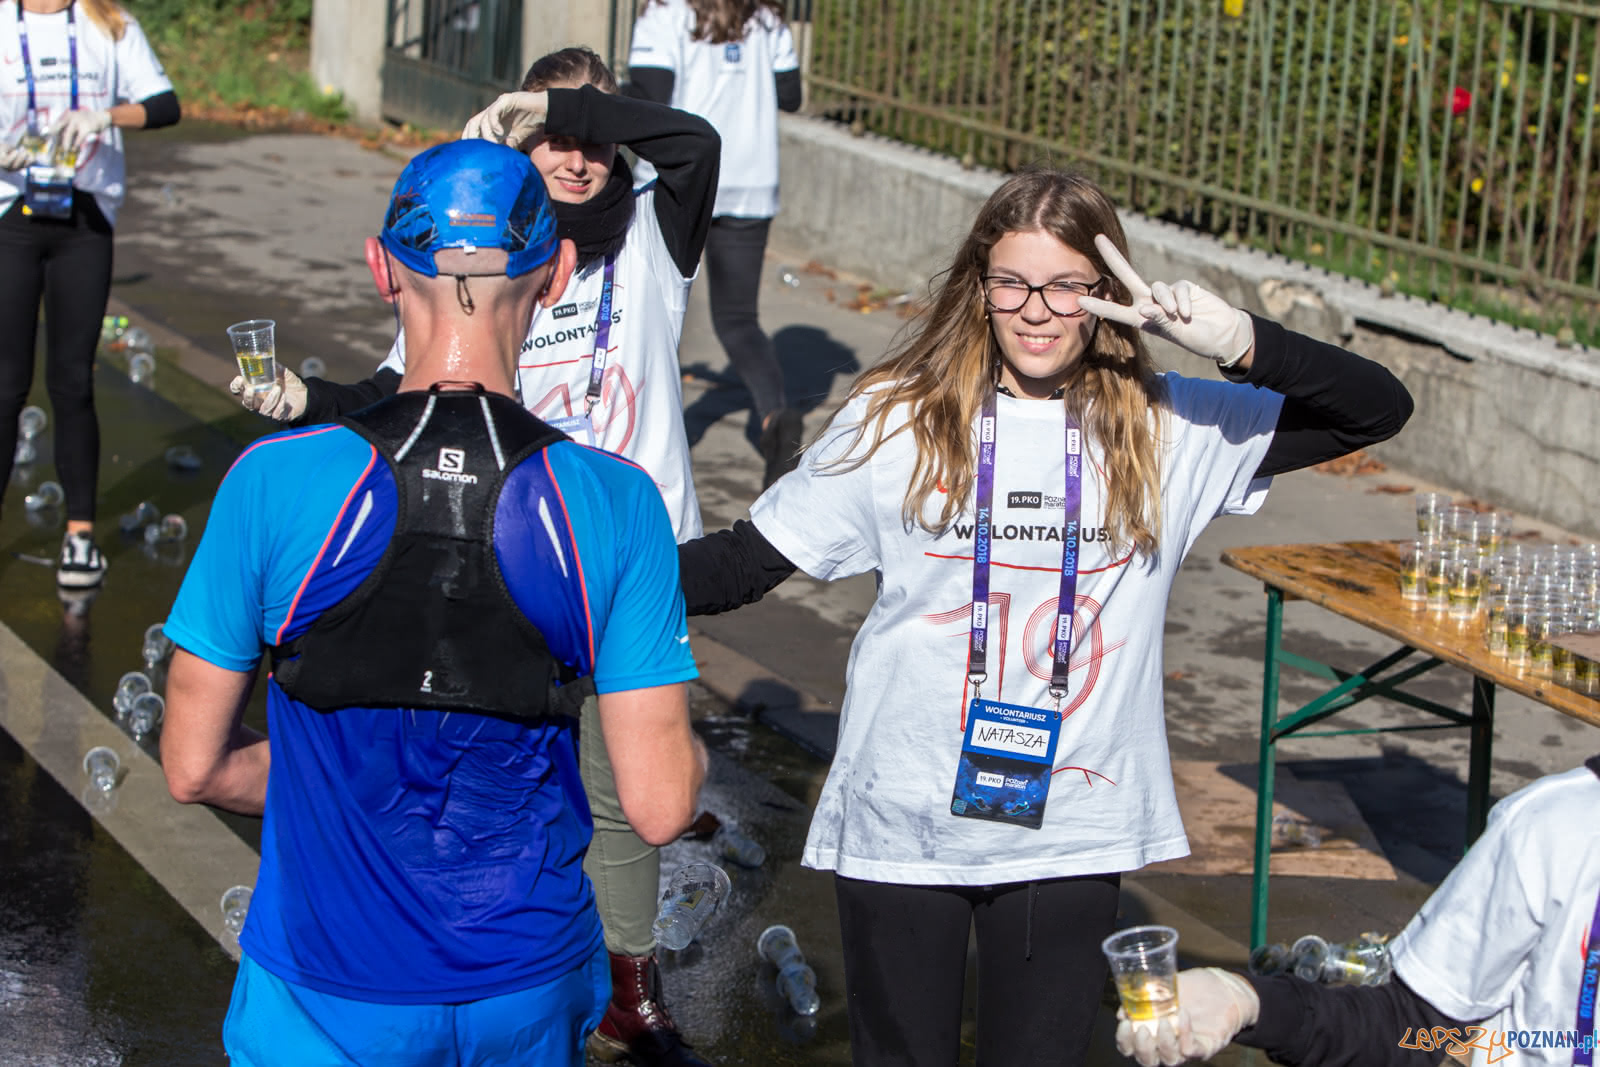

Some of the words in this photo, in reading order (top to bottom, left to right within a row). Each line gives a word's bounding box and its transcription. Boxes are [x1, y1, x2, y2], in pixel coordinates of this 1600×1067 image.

[953, 524, 1112, 543] WLONTAUS
[976, 507, 989, 564] 14.10.2018
[1064, 520, 1077, 577] 14.10.2018
[424, 670, 433, 686] 2
[985, 705, 1047, 722] WOLONTARIUSZ
[978, 726, 1047, 749] NATASZA
